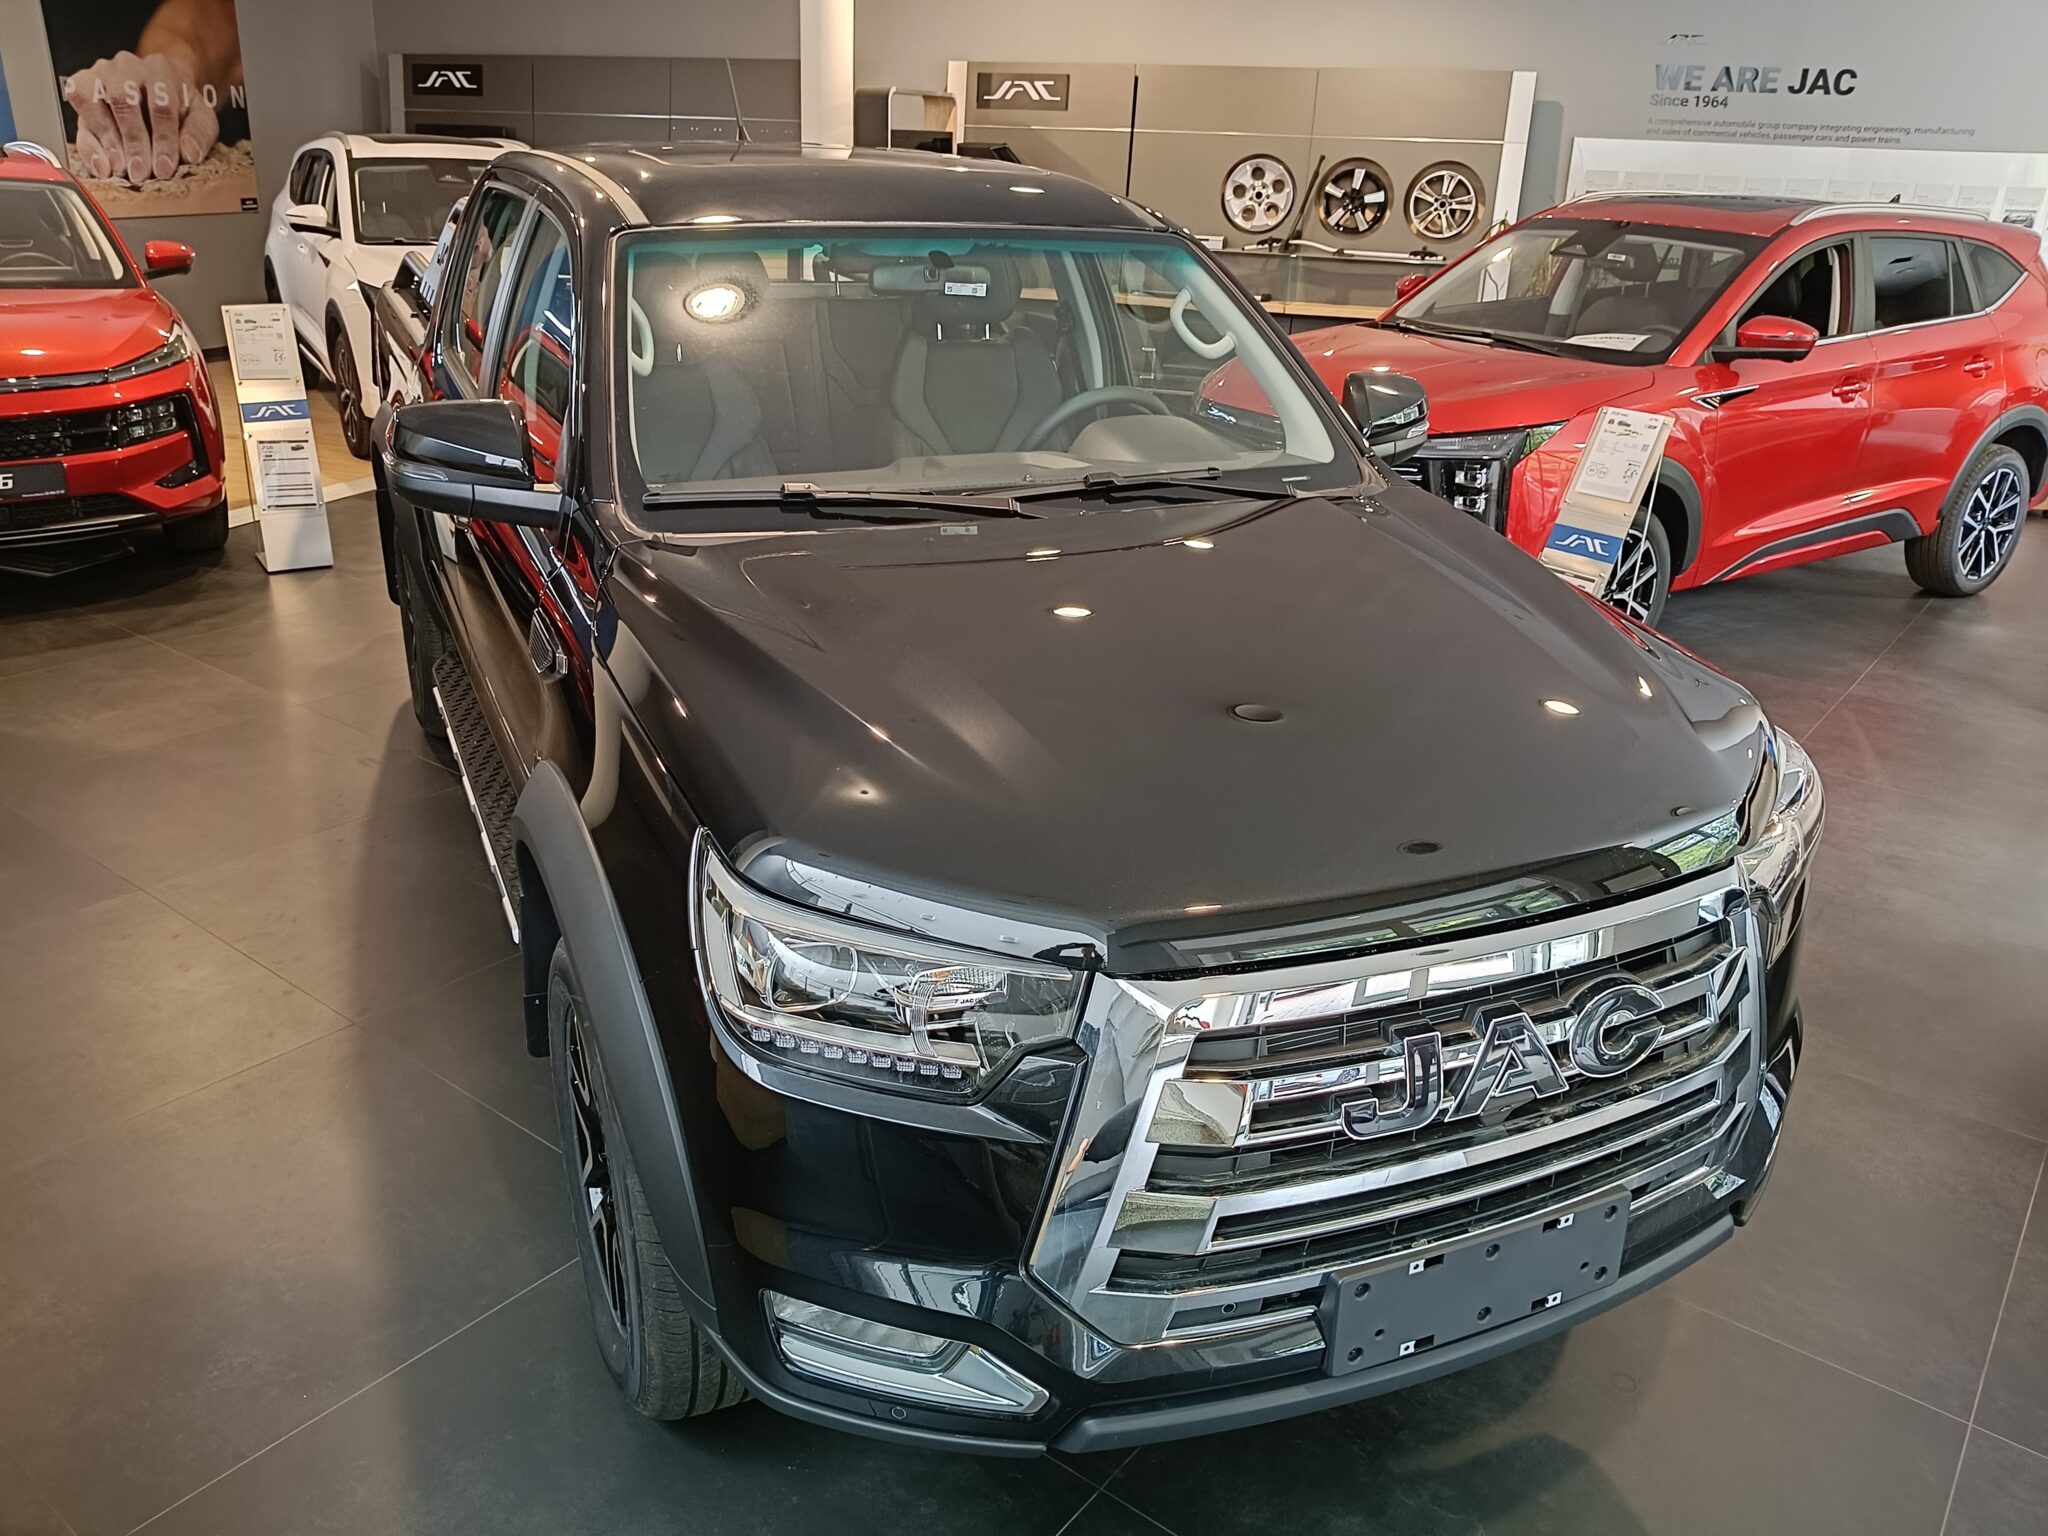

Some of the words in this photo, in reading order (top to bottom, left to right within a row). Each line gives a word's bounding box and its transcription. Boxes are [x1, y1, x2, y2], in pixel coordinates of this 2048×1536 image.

[418, 71, 477, 88] JAC
[1656, 64, 1705, 91] WE
[1711, 66, 1781, 93] ARE
[1788, 68, 1857, 95] JAC
[59, 76, 244, 109] PASSION
[984, 81, 1061, 100] JAC
[1650, 94, 1688, 107] Since
[1694, 95, 1729, 108] 1964
[1655, 118, 1712, 127] comprehensive
[1713, 119, 1756, 128] automobile
[1758, 122, 1780, 130] group
[1782, 123, 1818, 132] company
[1819, 124, 1862, 133] integrating
[1914, 126, 1975, 136] manufacturing
[1683, 128, 1692, 136] of
[1693, 130, 1737, 138] commercial
[1773, 133, 1814, 143] passenger
[1834, 135, 1850, 143] and
[1850, 136, 1877, 144] power
[250, 404, 302, 418] JAC
[1555, 534, 1610, 557] JAC
[1342, 983, 1666, 1141] JAC
